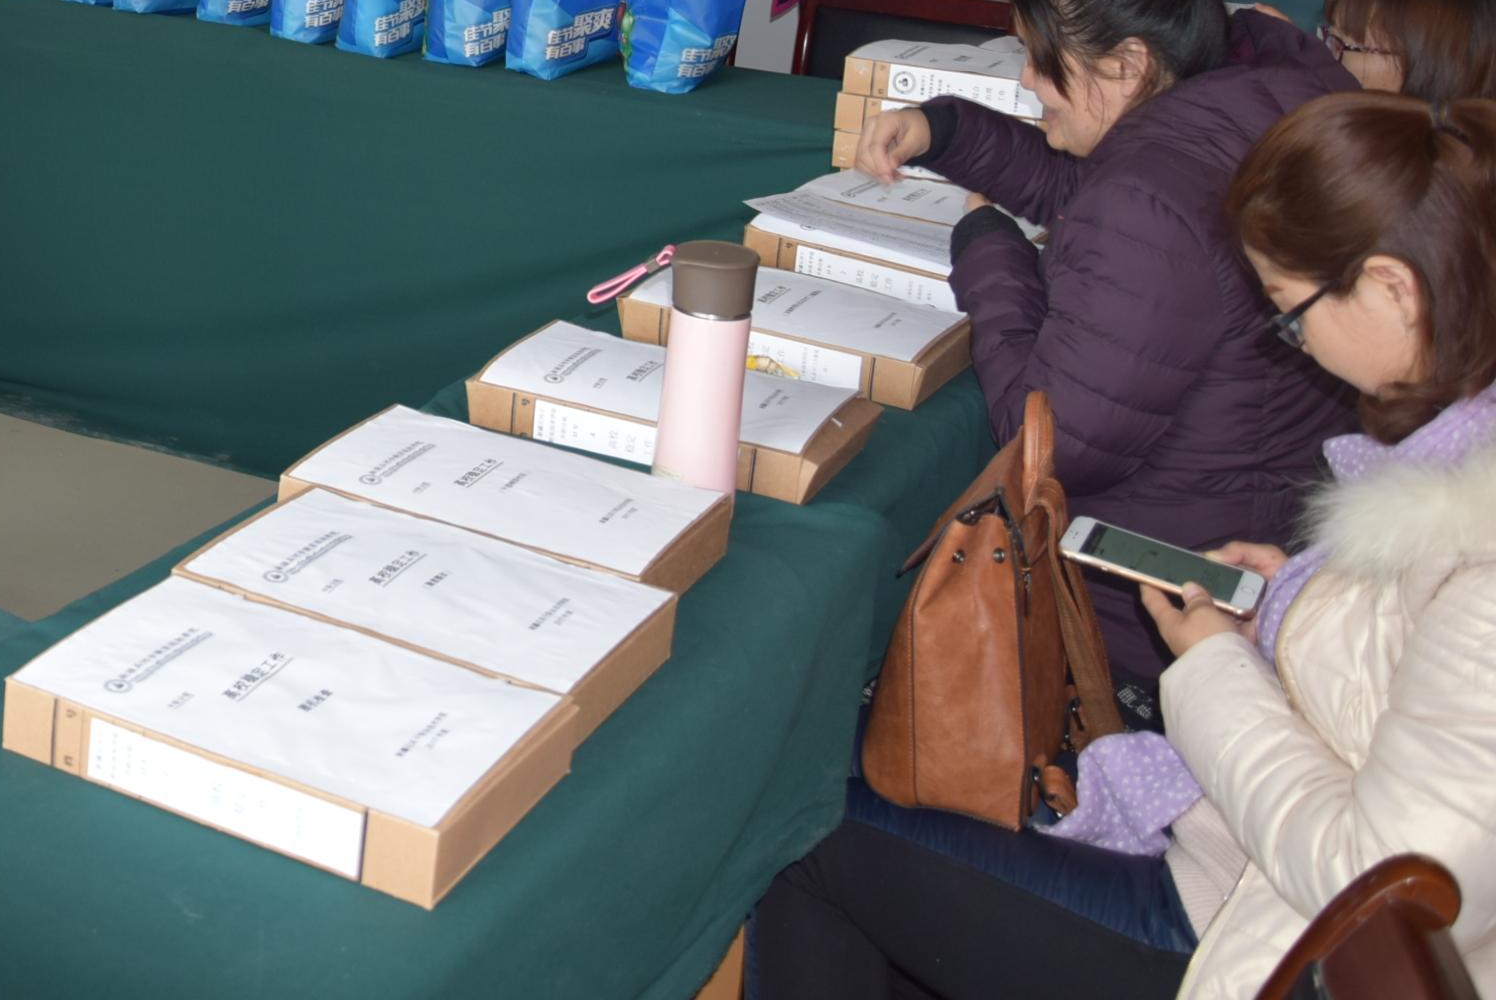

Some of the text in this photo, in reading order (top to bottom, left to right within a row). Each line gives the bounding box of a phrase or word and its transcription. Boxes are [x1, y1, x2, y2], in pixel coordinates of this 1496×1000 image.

[547, 8, 615, 44] 佳节聚爽
[545, 37, 586, 60] 有百事
